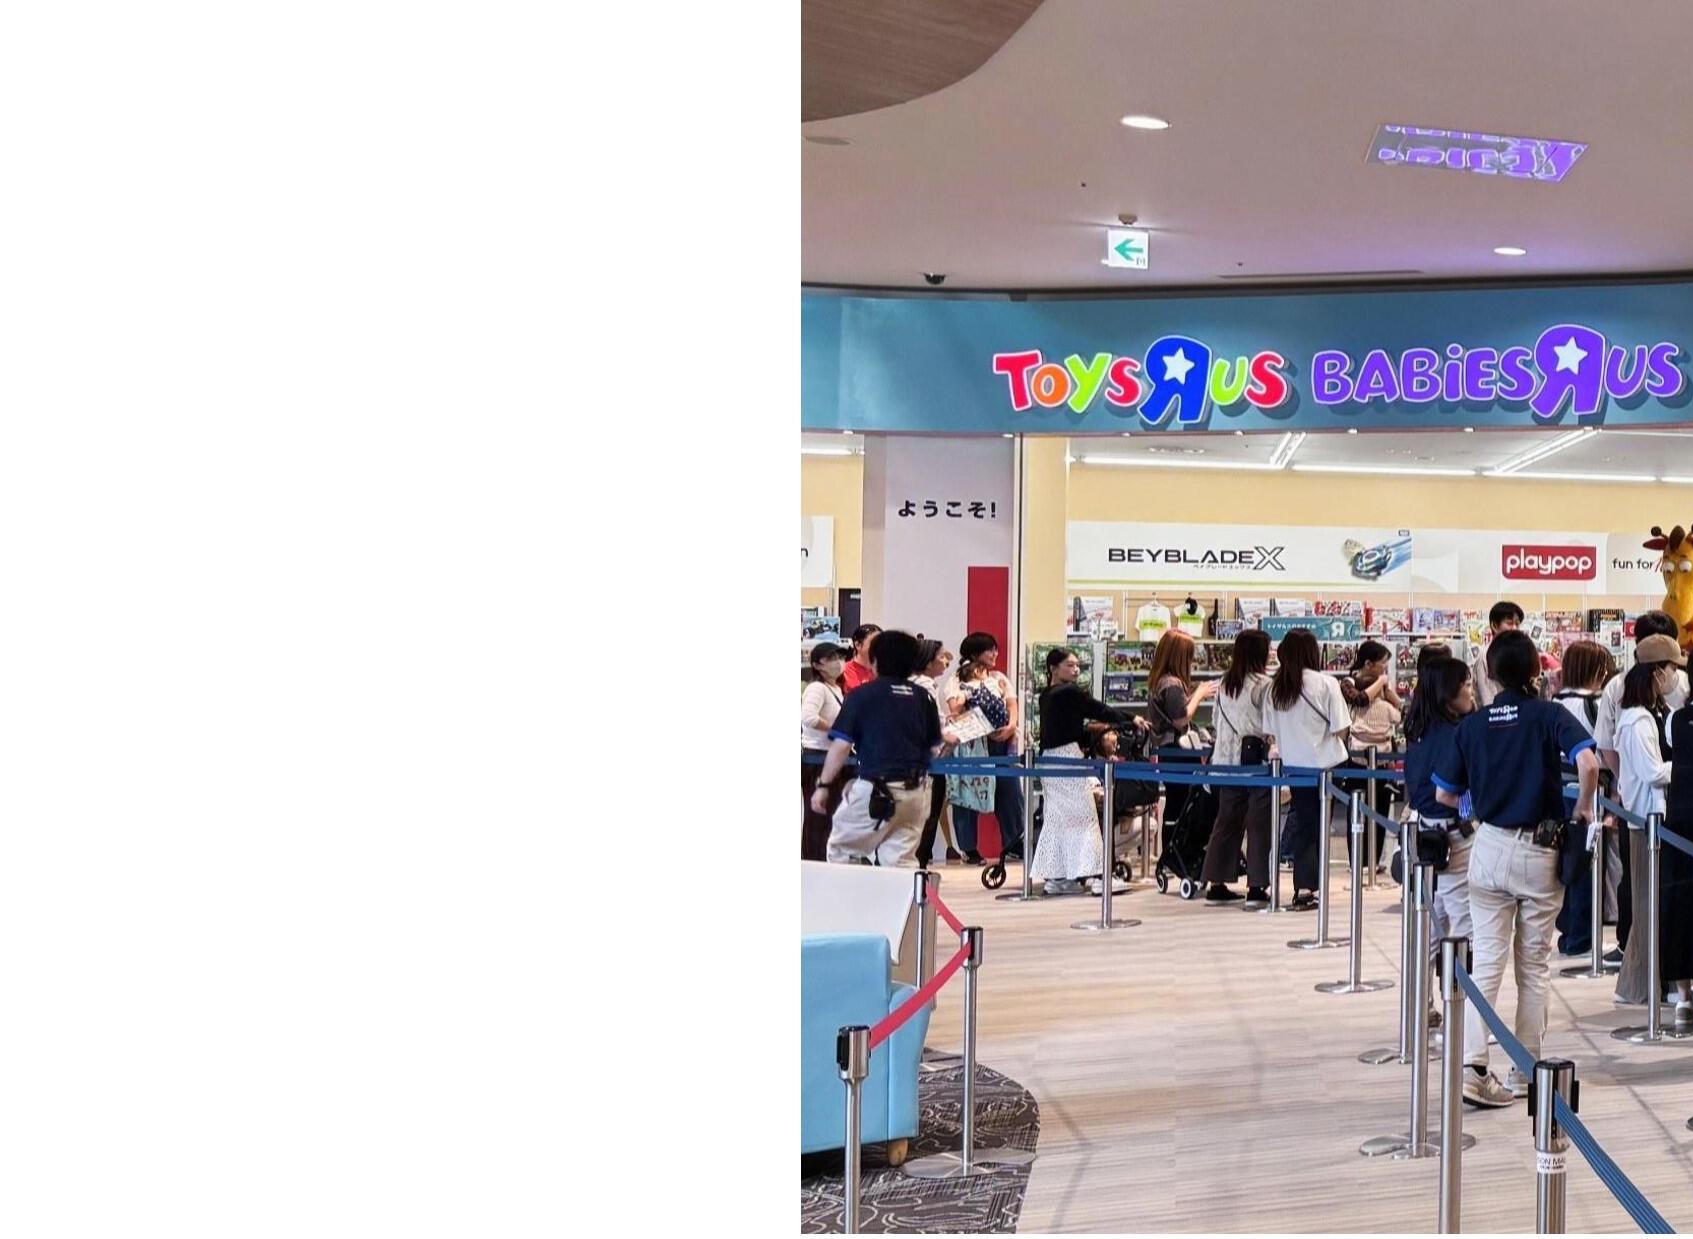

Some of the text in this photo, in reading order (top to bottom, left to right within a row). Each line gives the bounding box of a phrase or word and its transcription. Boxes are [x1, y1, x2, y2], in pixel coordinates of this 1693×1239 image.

[1506, 548, 1592, 575] playpop
[1613, 559, 1633, 569] fun
[1637, 559, 1653, 569] for
